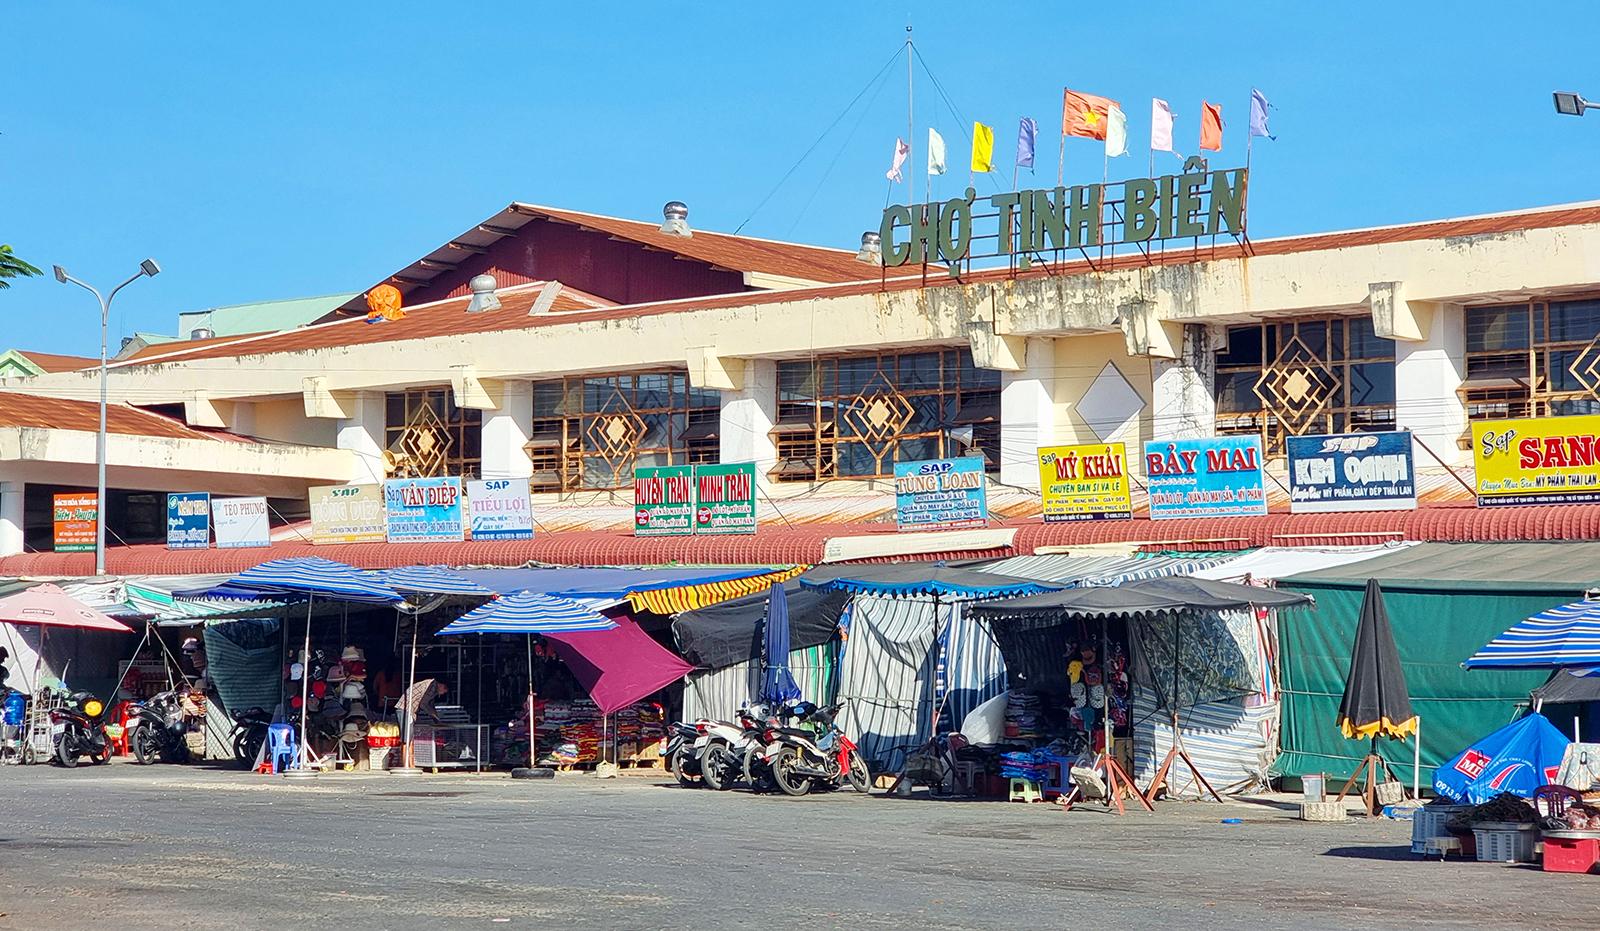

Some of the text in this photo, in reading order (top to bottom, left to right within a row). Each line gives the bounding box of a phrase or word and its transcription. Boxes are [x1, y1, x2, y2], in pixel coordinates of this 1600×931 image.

[880, 156, 1249, 278] CHỢ TỊNH BIÊN
[1082, 446, 1122, 479] KHẢI
[1147, 443, 1259, 476] BẢY MAI
[1519, 435, 1600, 469] SAN
[486, 480, 510, 492] SẠP
[896, 472, 980, 493] TÙNG LOAN
[1294, 458, 1336, 485] KIM
[400, 482, 425, 506] VÂN
[428, 480, 457, 511] ĐIỆP
[699, 475, 725, 503] MINH
